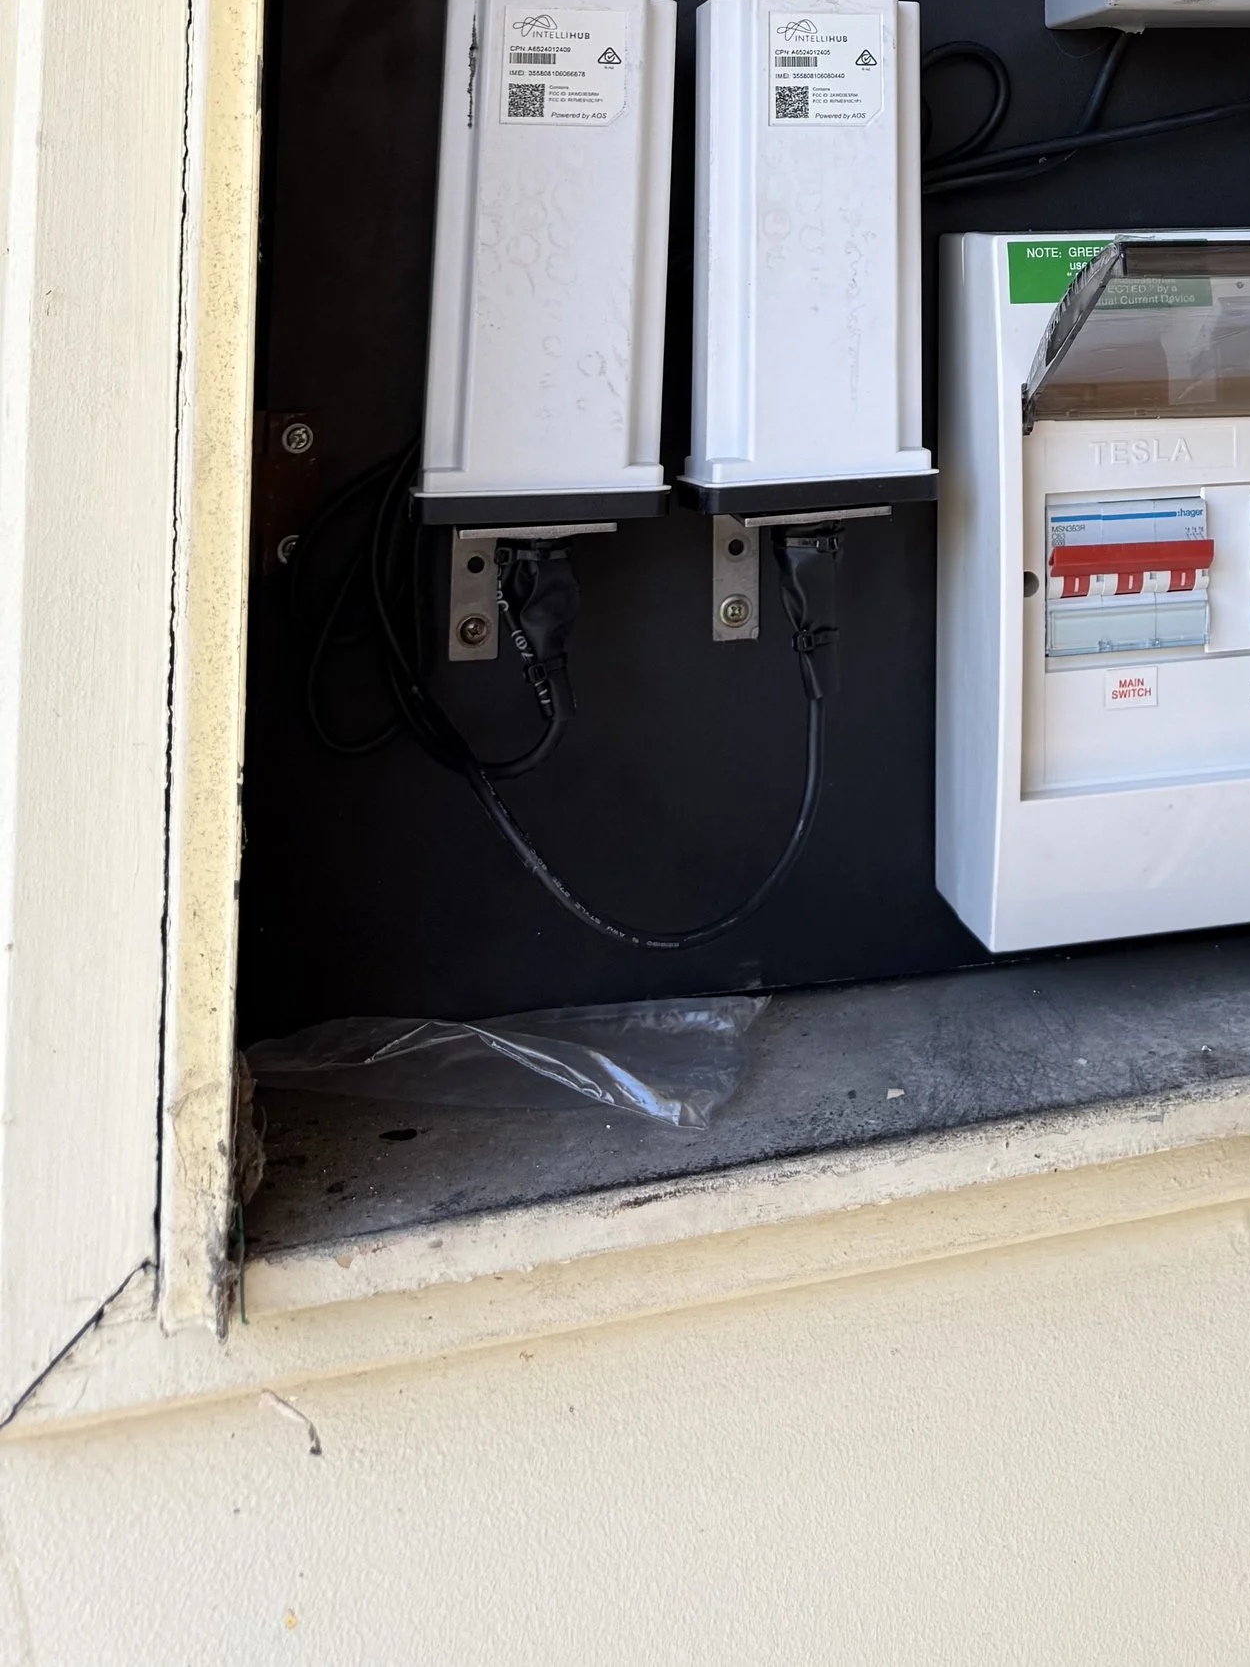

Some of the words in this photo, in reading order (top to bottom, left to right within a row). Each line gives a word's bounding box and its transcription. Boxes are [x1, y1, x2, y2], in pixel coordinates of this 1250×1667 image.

[532, 30, 591, 40] INTELLIHUB
[795, 35, 848, 43] INTELLIHUB
[582, 112, 589, 120] by
[1026, 247, 1063, 258] NOTE:
[1068, 246, 1105, 258] GREE
[1121, 294, 1158, 304] Current
[1088, 436, 1193, 467] TESLA
[1118, 678, 1144, 688] MAIN
[1112, 688, 1152, 700] SWITCH
